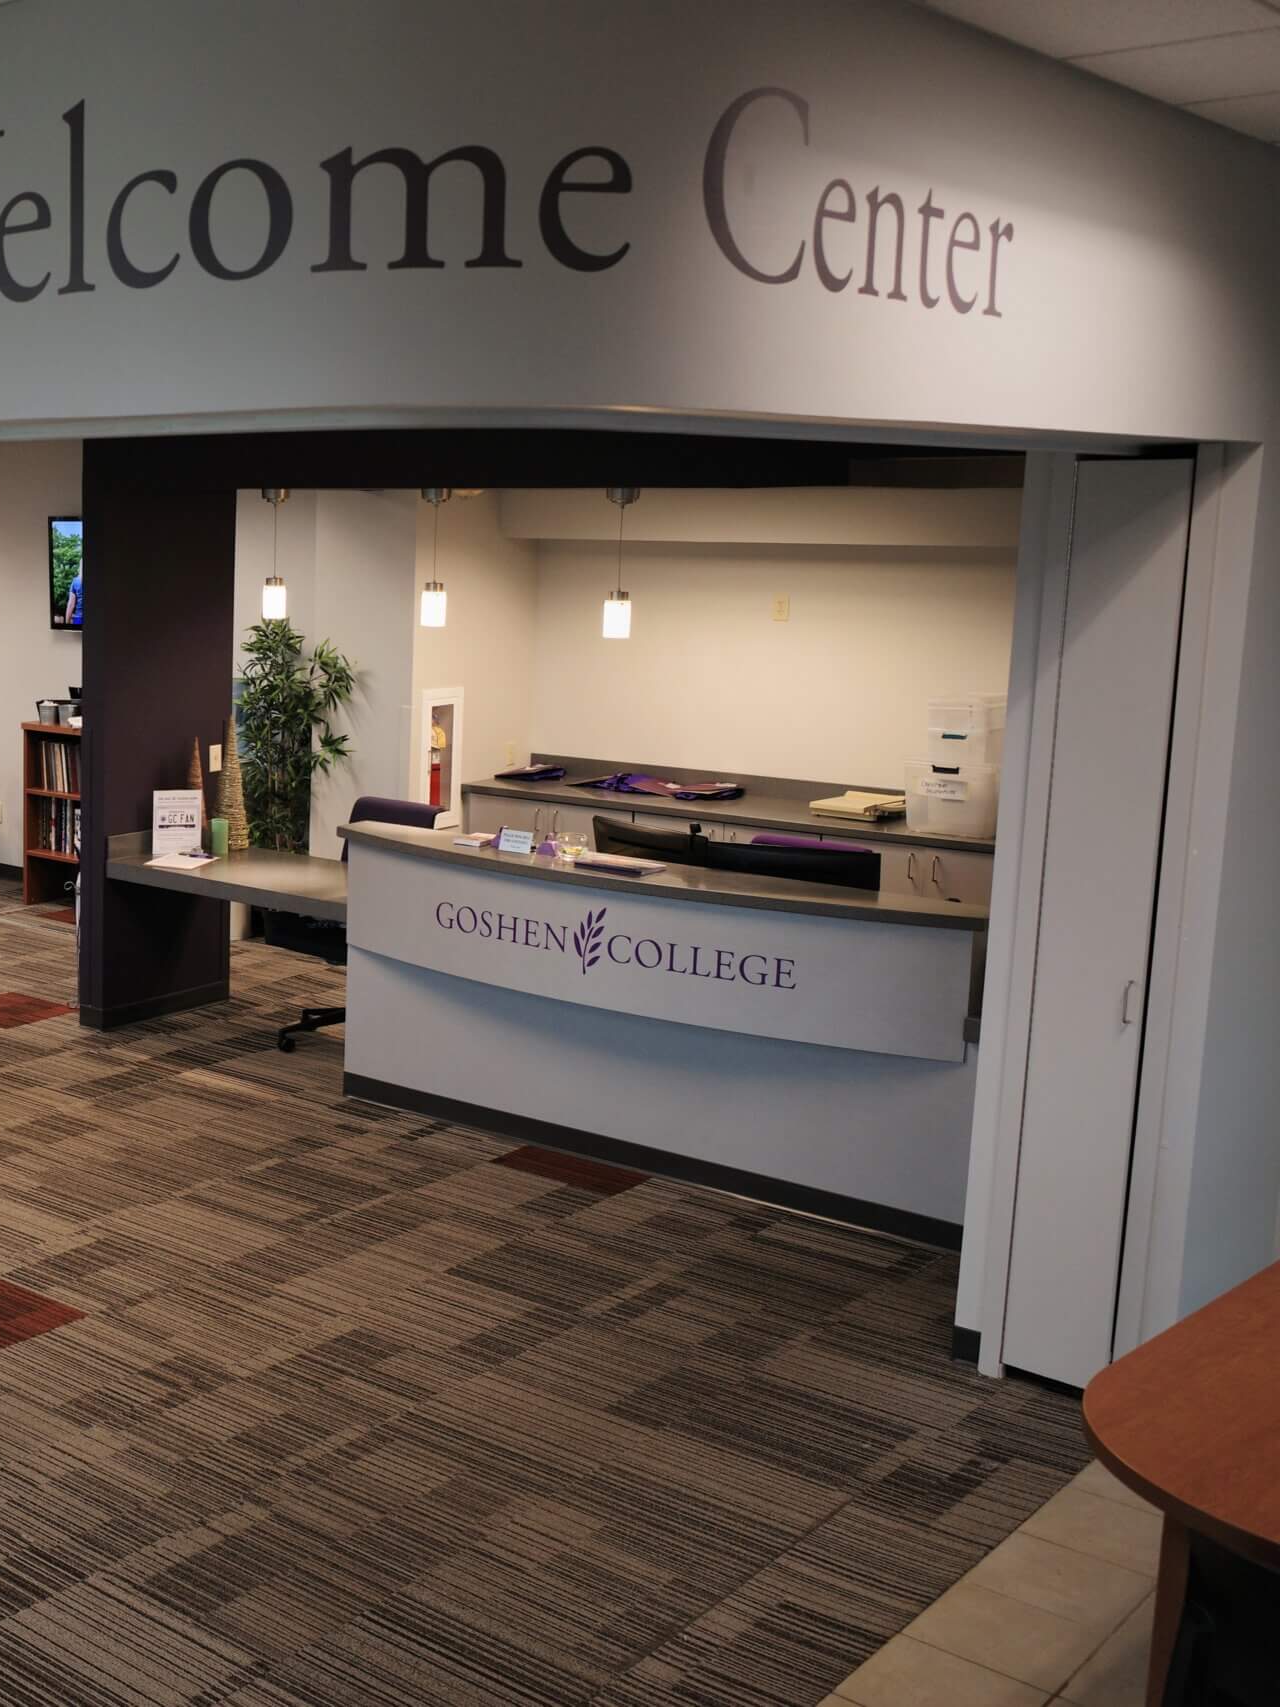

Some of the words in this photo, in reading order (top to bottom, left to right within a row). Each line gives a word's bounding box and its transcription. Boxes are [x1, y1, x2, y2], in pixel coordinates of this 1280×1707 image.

[702, 86, 1014, 318] Center
[180, 813, 195, 824] FAN
[435, 901, 568, 953] GOSHEN
[607, 934, 797, 991] COLLEGE
